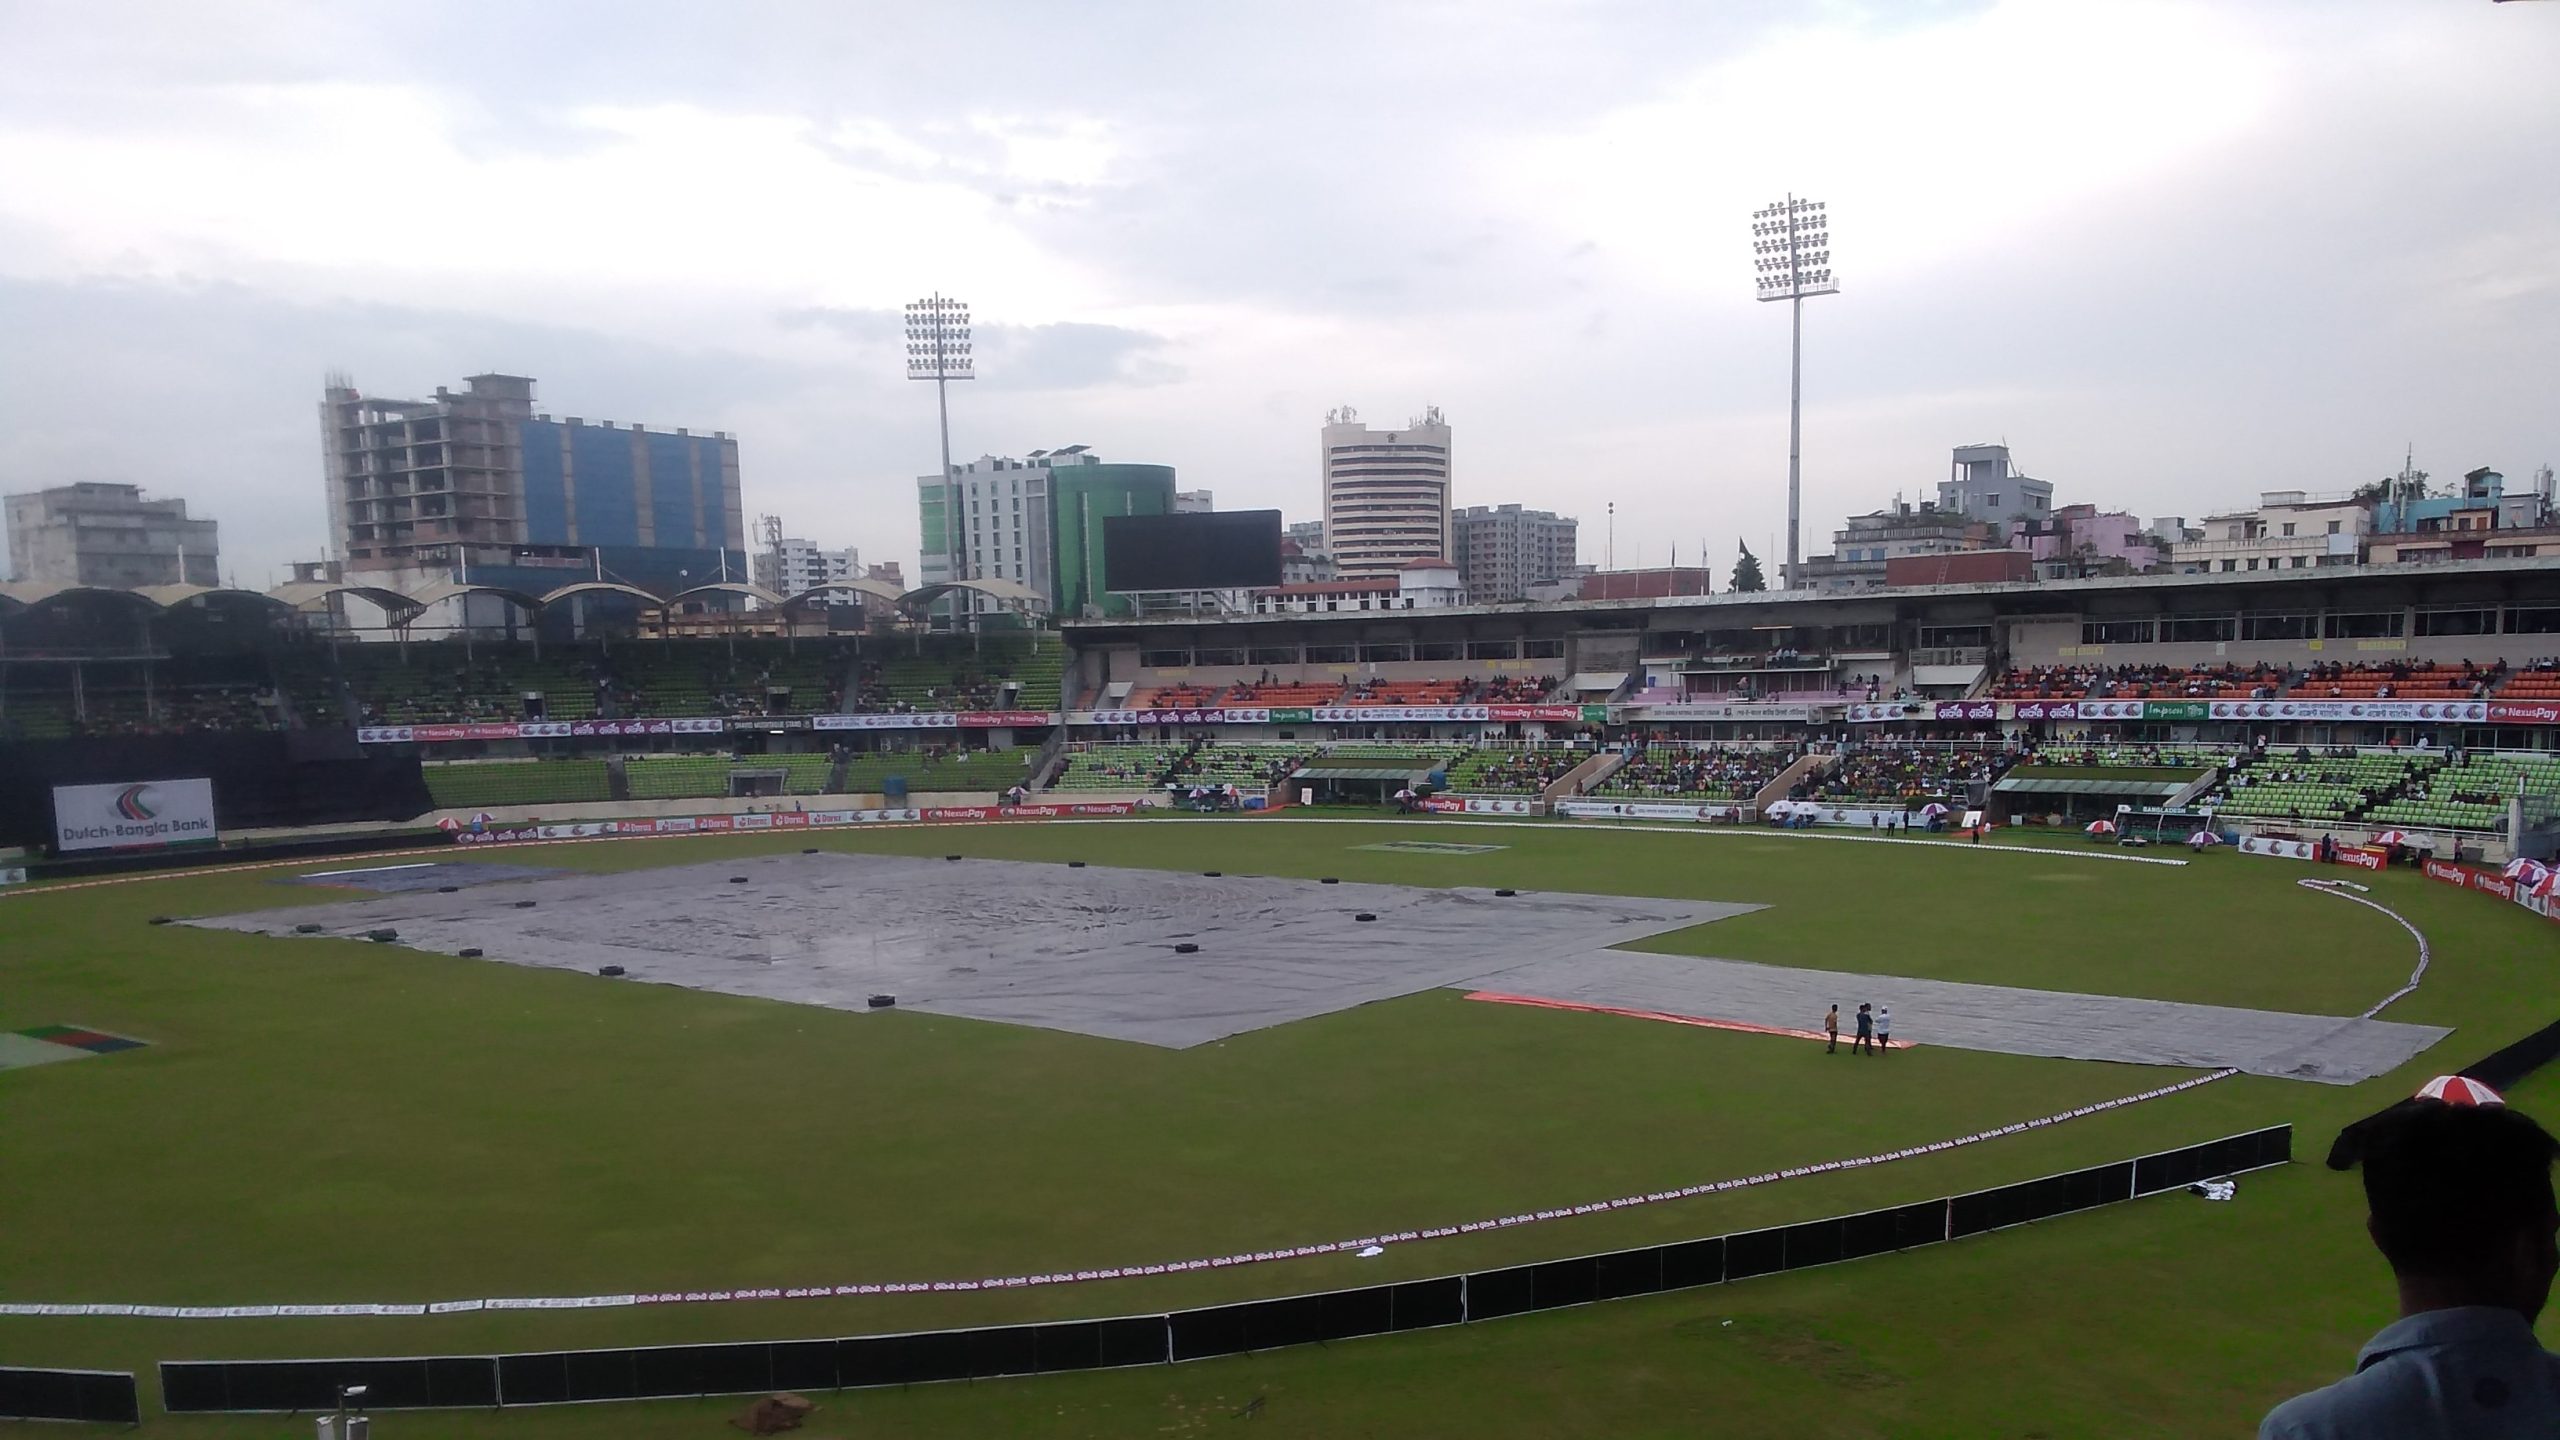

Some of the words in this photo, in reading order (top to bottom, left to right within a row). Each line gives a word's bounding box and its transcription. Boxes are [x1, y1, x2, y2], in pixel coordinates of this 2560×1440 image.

[1016, 714, 1048, 724] NexusPay
[1501, 709, 1532, 719] NexusPay
[1545, 709, 1576, 719] NexusPay
[2508, 707, 2558, 721] NexusPay
[969, 715, 1002, 725] NexusPay
[944, 809, 986, 819] NexusPay
[1016, 806, 1057, 817] NexusPay
[1087, 804, 1128, 814] NexusPay
[2143, 806, 2186, 814] BANGLADESH
[63, 822, 168, 841] Dutch-Bangla
[172, 818, 209, 833] Bank
[2437, 864, 2466, 887] NexusPay
